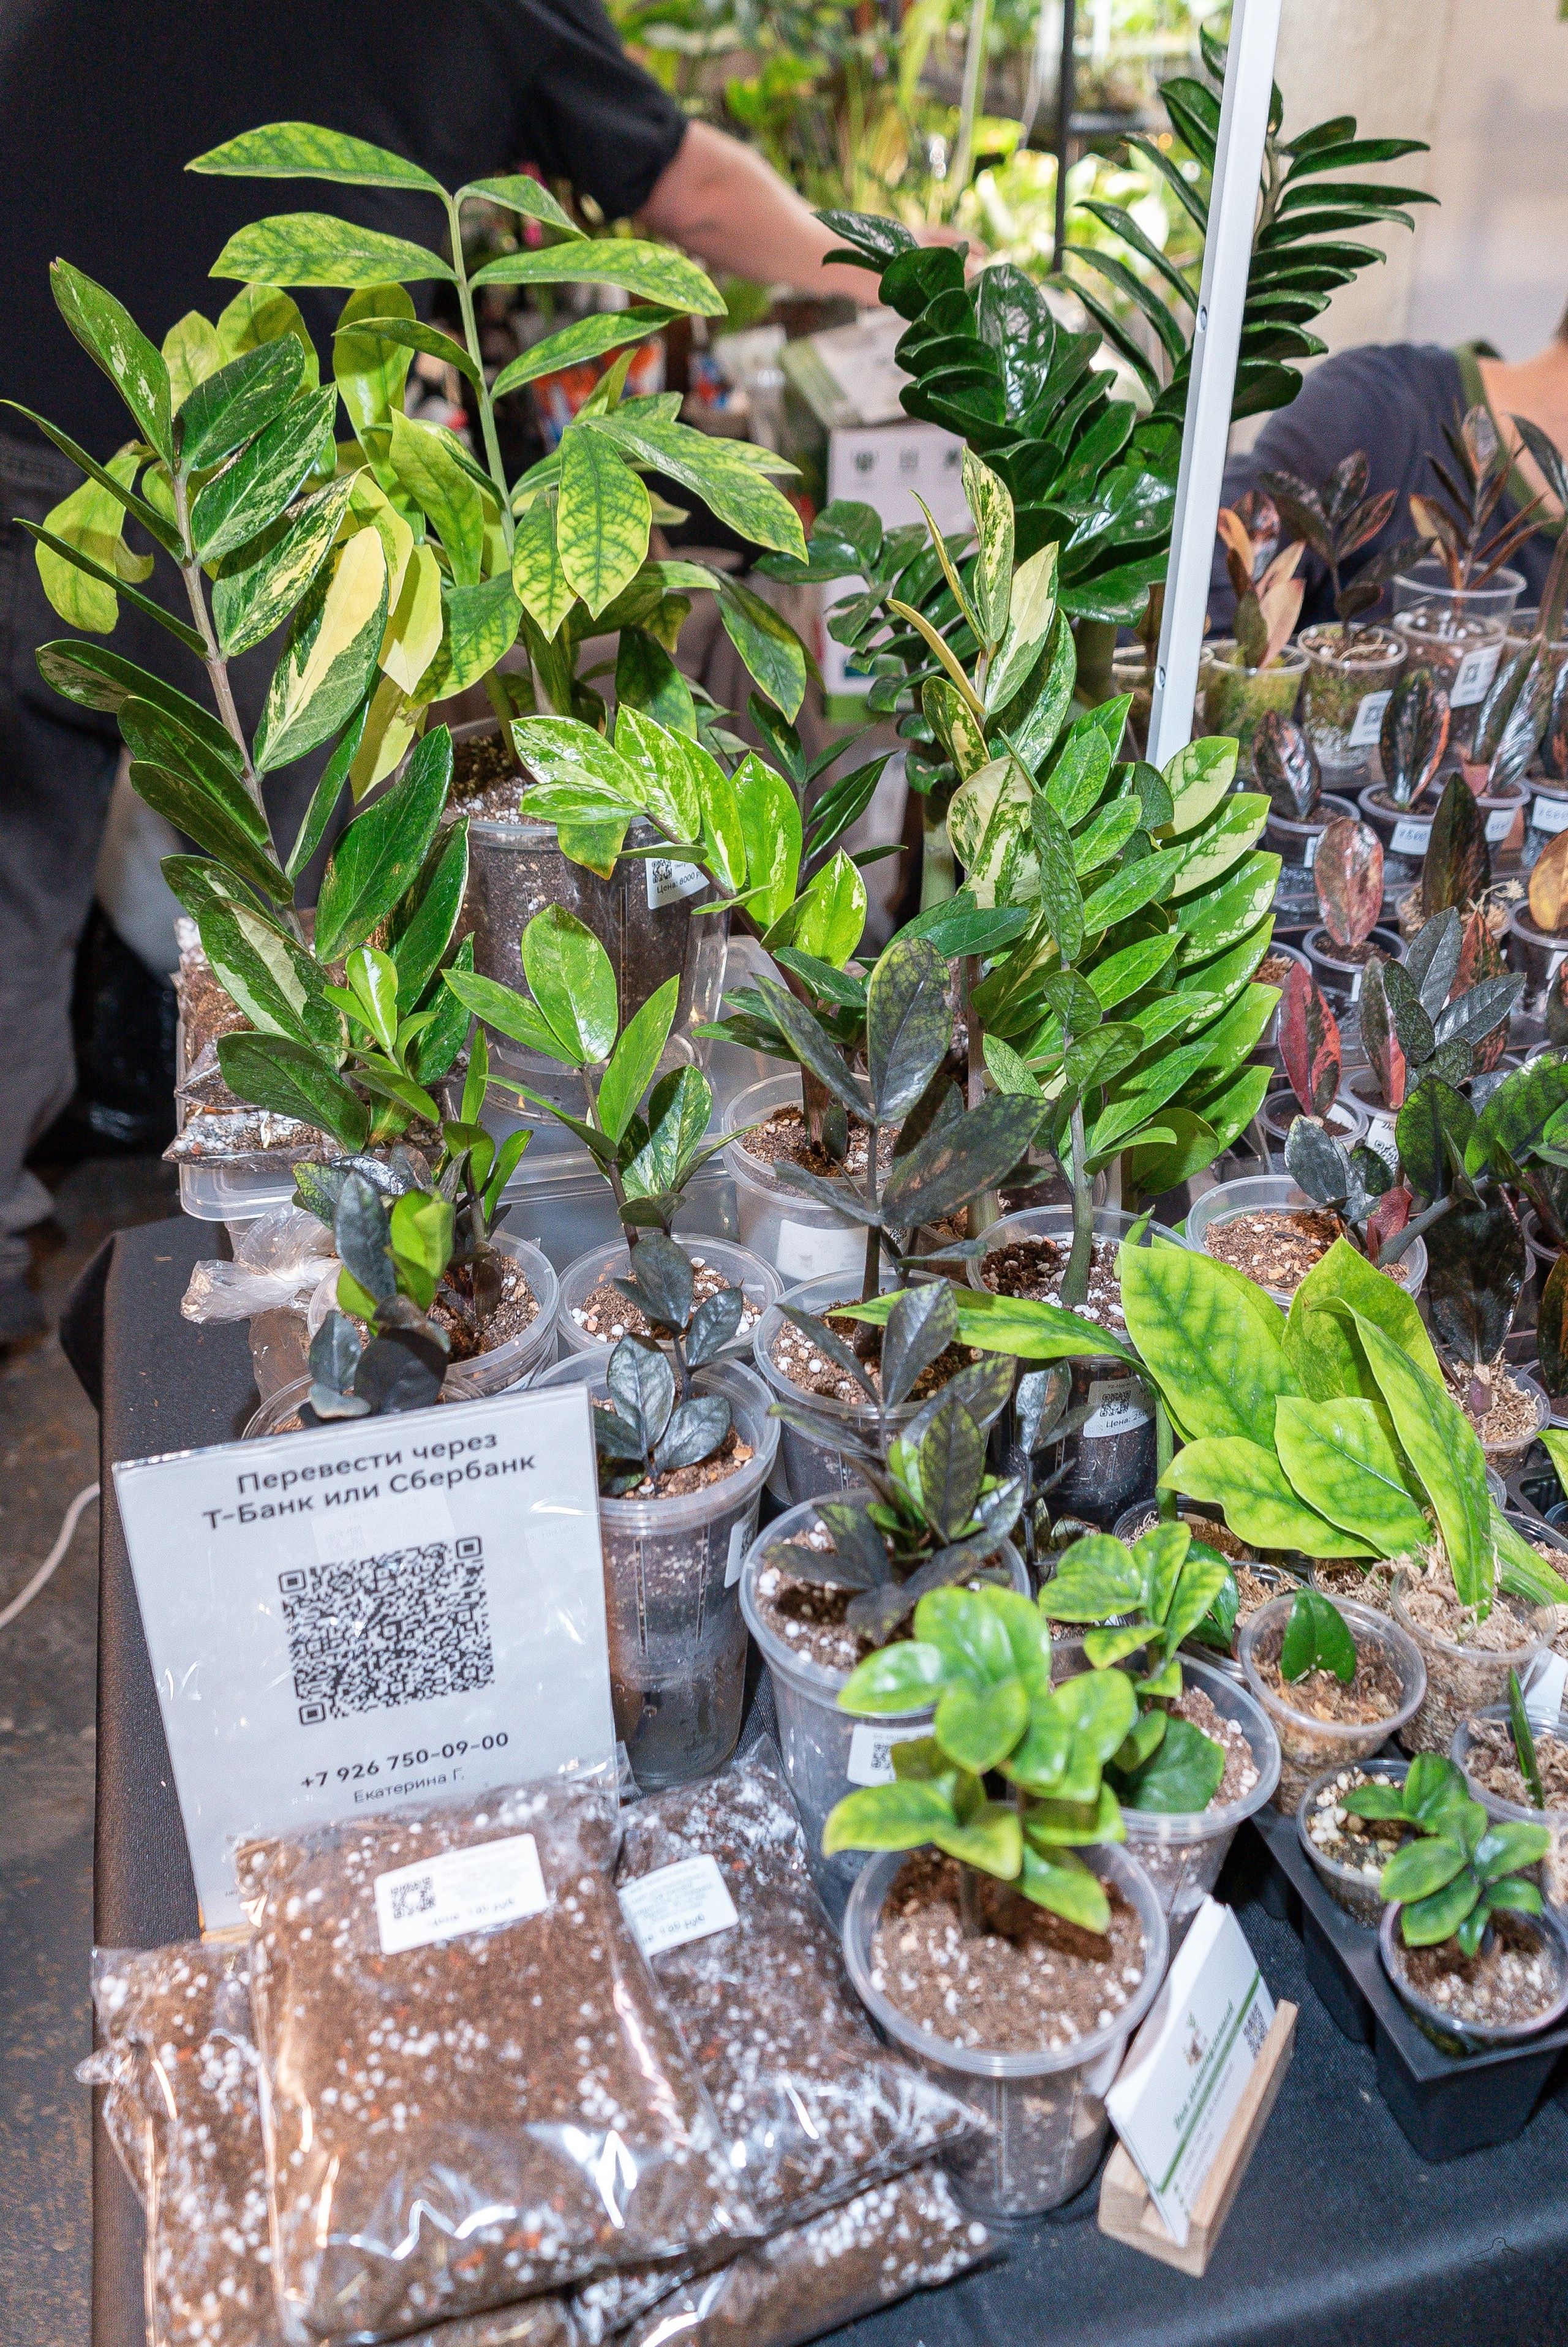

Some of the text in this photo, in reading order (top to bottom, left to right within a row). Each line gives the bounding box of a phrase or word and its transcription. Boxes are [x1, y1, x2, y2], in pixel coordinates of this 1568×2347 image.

[202, 1455, 536, 1529] Т-Банк или Сбербанк
[238, 1433, 498, 1494] Перевести через
[300, 1732, 509, 1787] +7 926 750-09-00
[353, 1772, 447, 1804] Екатерина
